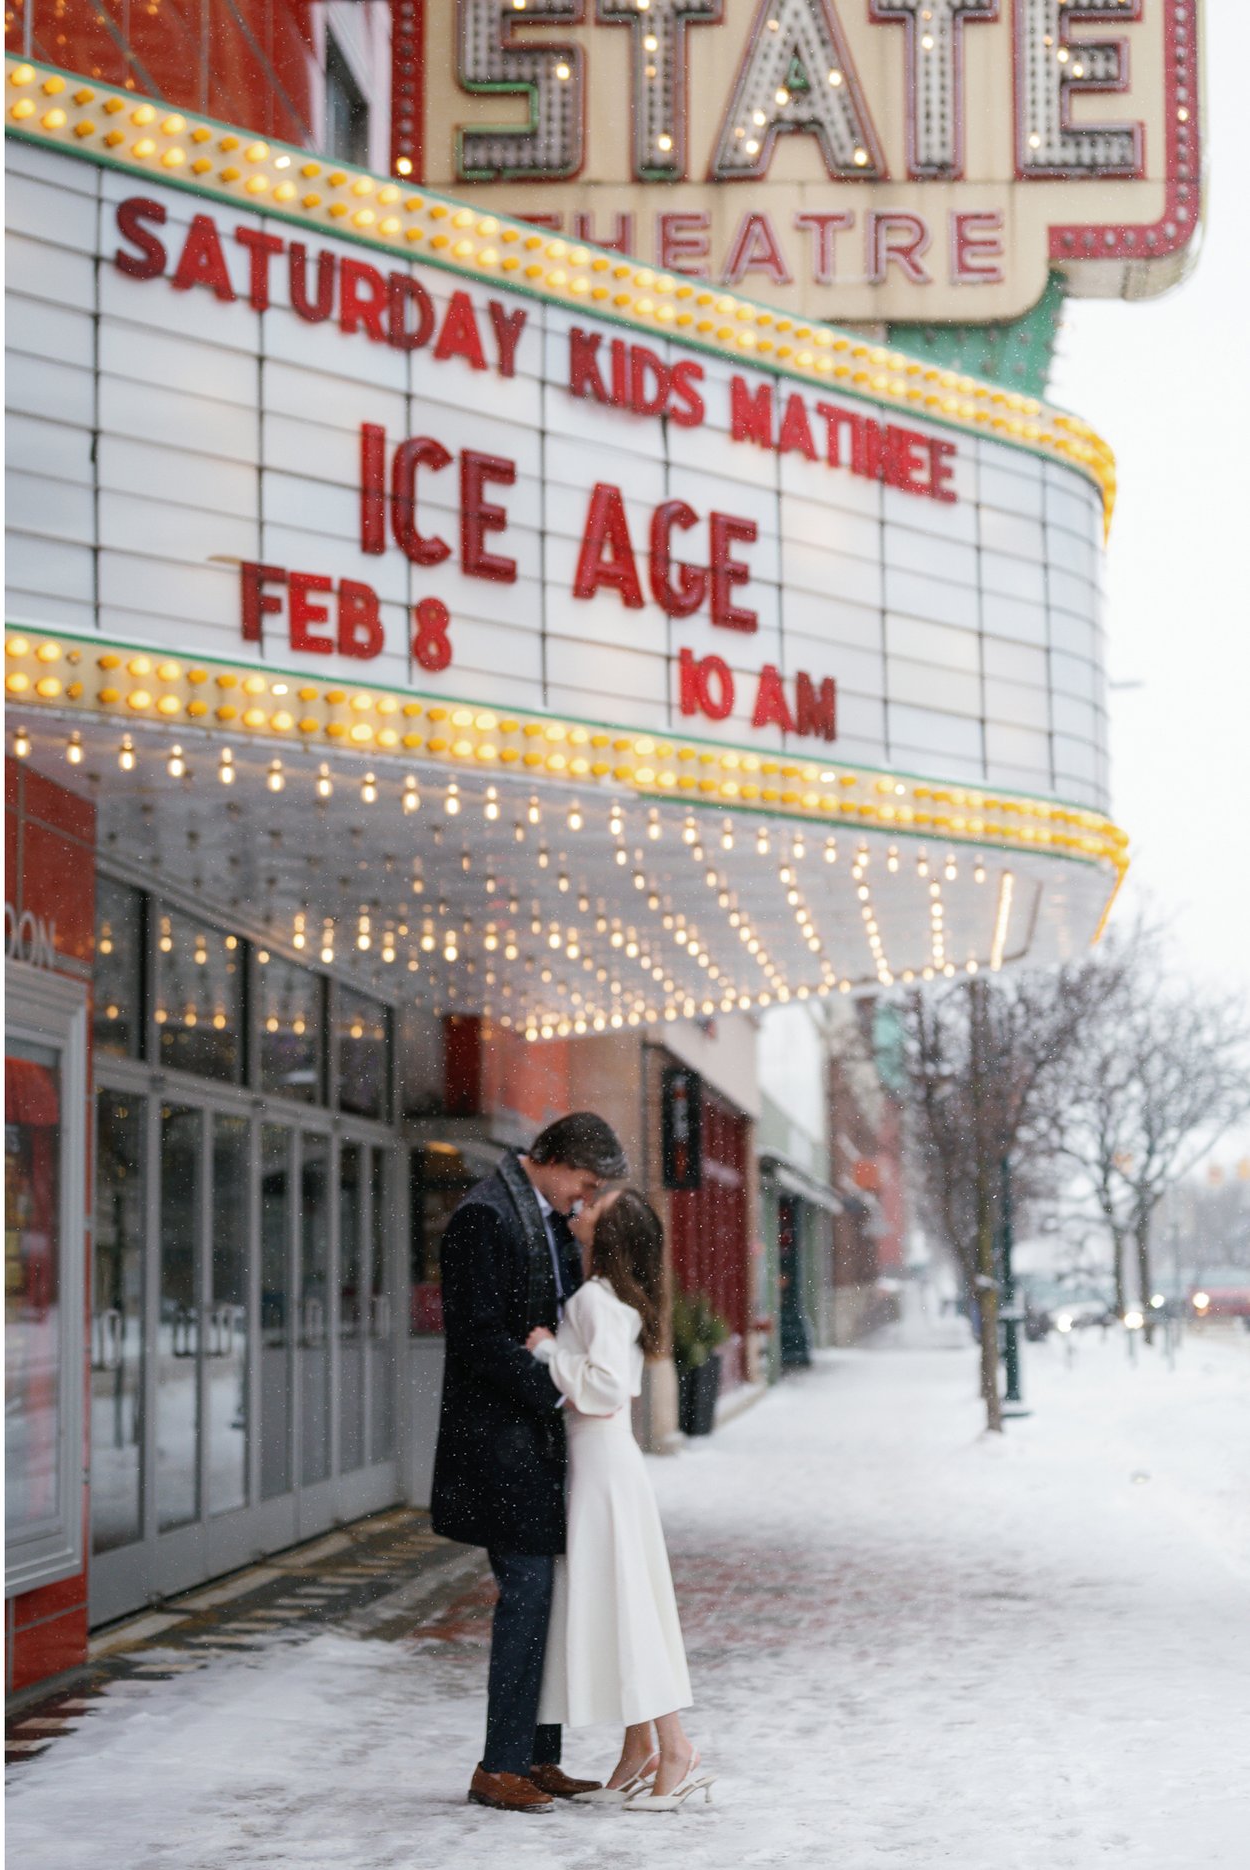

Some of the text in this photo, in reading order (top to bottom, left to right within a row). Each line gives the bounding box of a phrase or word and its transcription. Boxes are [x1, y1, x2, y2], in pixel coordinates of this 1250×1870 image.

[454, 0, 1147, 182] STATE
[513, 209, 1007, 286] HEATRE
[113, 196, 958, 503] SATURDAY KIDS MATINEE
[359, 421, 758, 633] ICE AGE
[239, 560, 453, 672] FEB 8
[678, 647, 838, 741] 10 AM
